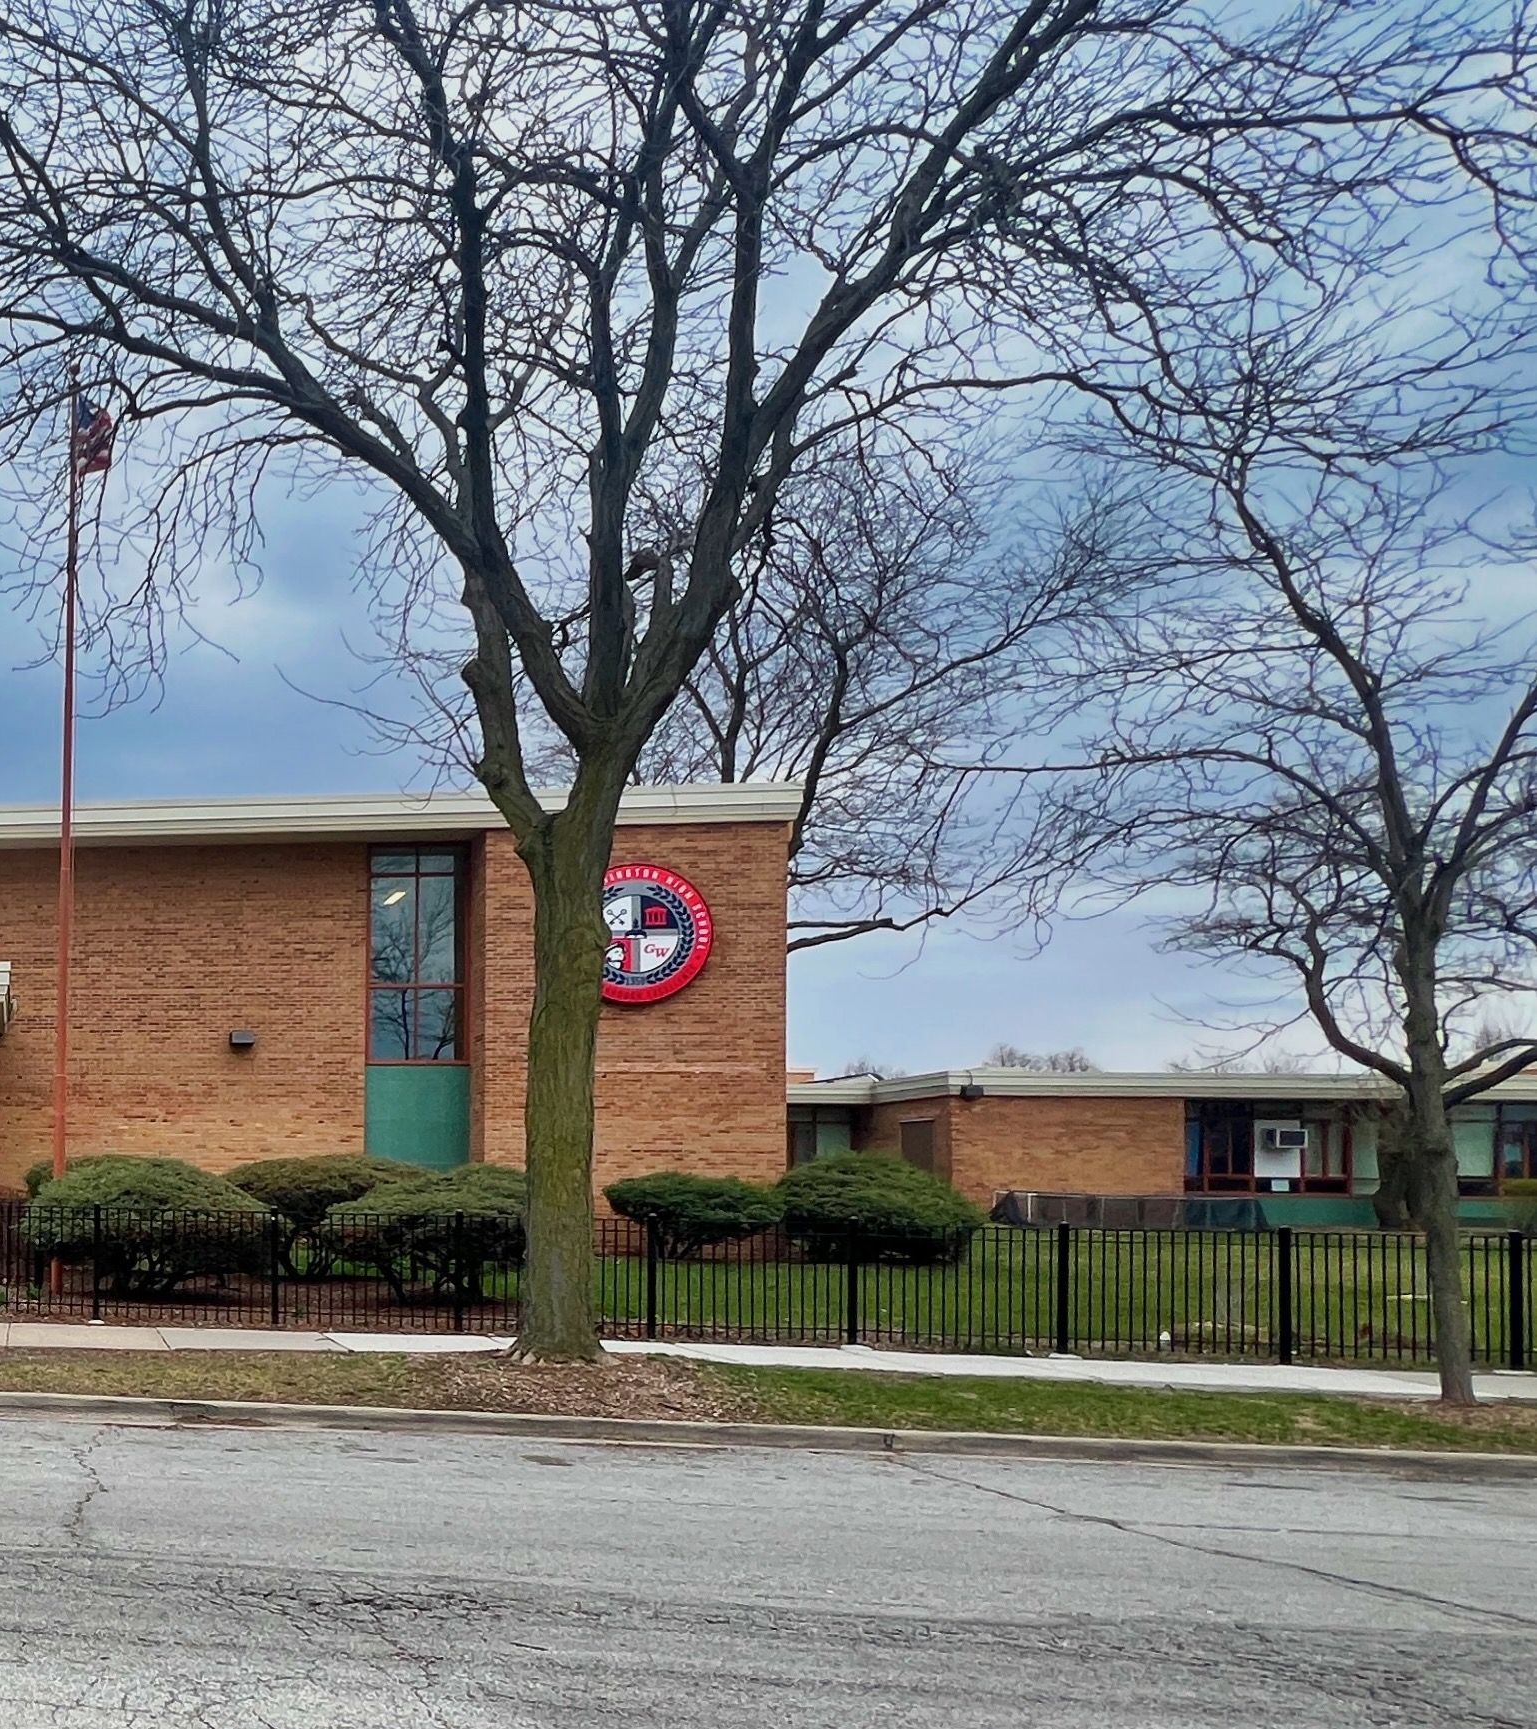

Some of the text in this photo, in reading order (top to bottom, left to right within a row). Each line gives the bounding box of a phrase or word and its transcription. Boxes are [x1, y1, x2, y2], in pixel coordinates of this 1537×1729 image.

[666, 876, 694, 899] HIGH
[692, 904, 709, 949] SCHOOL
[644, 944, 670, 957] GW
